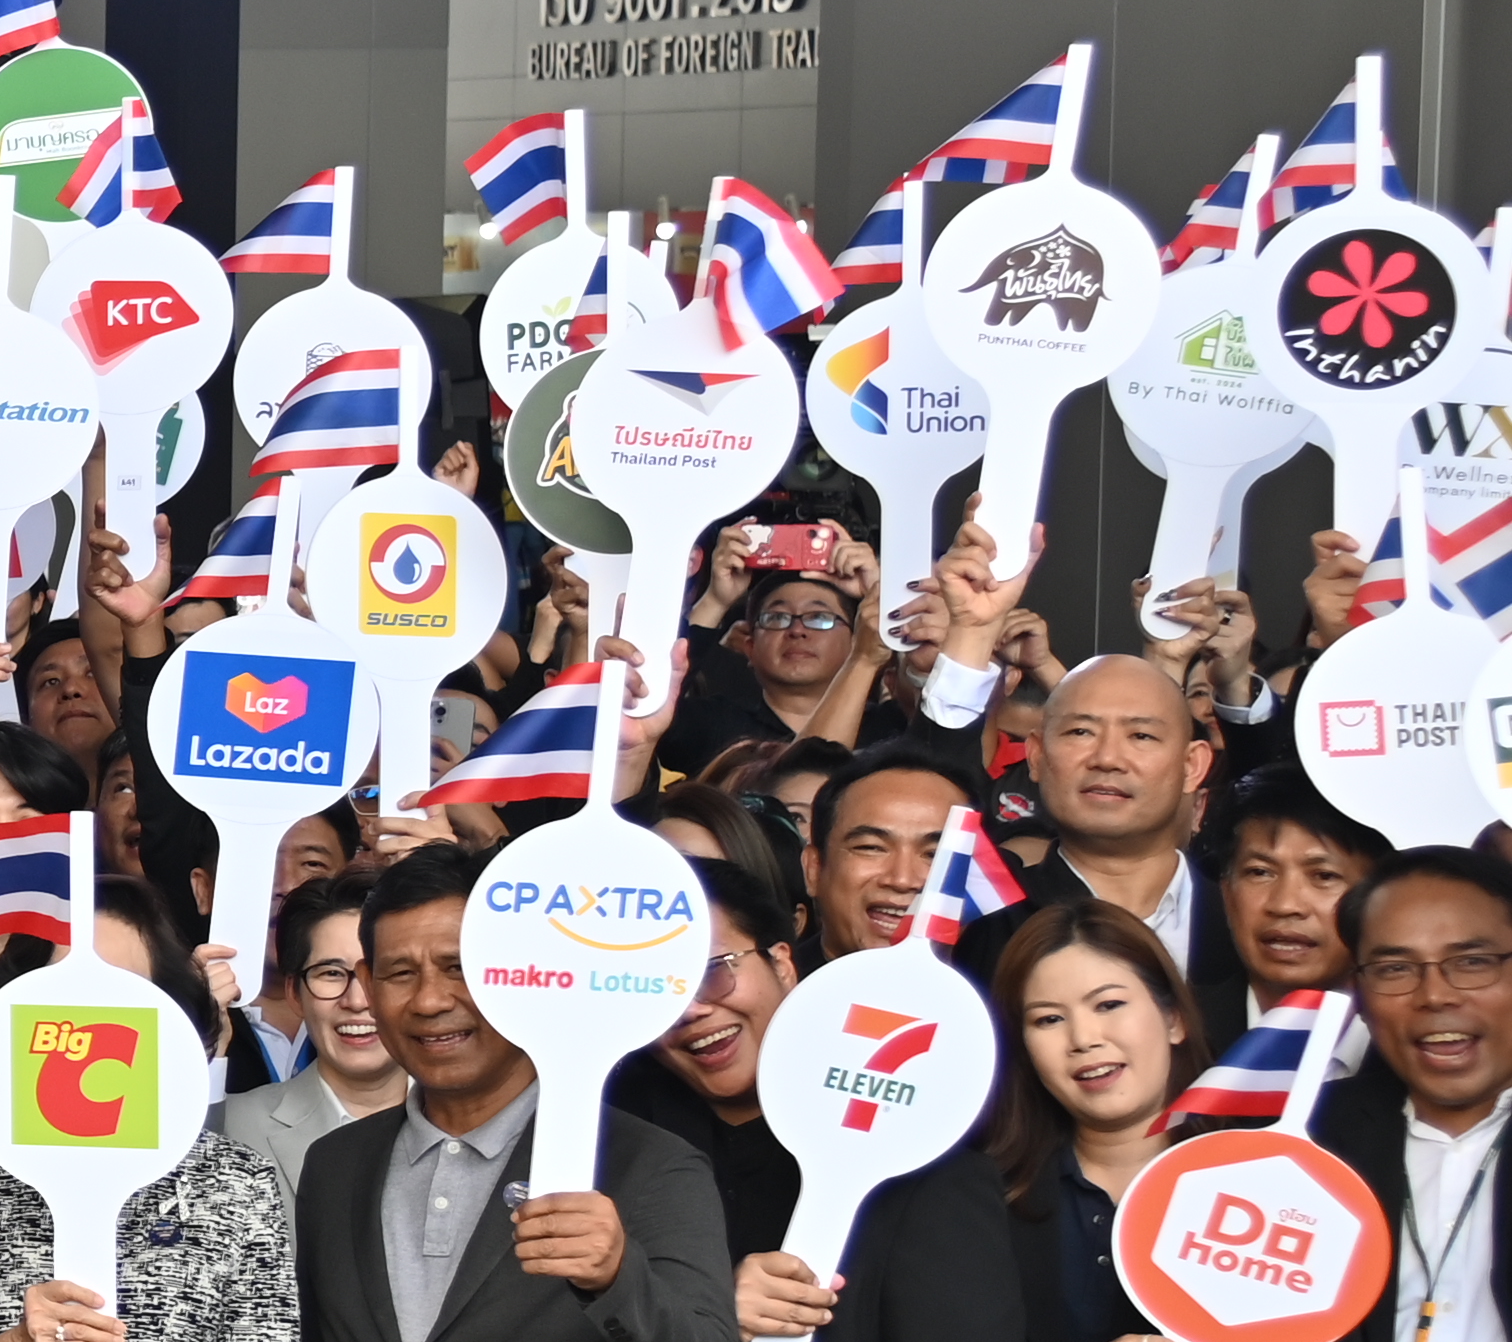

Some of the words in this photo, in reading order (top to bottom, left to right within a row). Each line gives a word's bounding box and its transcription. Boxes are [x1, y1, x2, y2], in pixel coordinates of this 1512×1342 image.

[526, 40, 611, 81] BUREAU
[622, 37, 652, 78] OF
[659, 30, 754, 76] FOREIGN
[106, 296, 174, 327] KTC
[1286, 323, 1448, 386] Inthanin
[901, 385, 960, 410] Thai
[1127, 380, 1155, 401] By
[1164, 384, 1209, 405] Thai
[1217, 393, 1295, 417] Wolffia
[613, 424, 753, 451] ไปรษณีย์ไทย
[906, 411, 986, 434] Union
[610, 450, 678, 469] Thailand
[681, 453, 718, 471] Post
[366, 611, 449, 629] SUSCO
[243, 689, 290, 716] Laz
[1396, 725, 1461, 749] POST
[188, 734, 331, 777] Lazada
[485, 880, 541, 914] CP
[543, 884, 695, 923] AXTRA
[482, 963, 574, 991] makro
[588, 969, 687, 997] Lotus's
[30, 1020, 92, 1061] Big
[35, 1021, 140, 1138] C
[841, 1002, 938, 1133] 7
